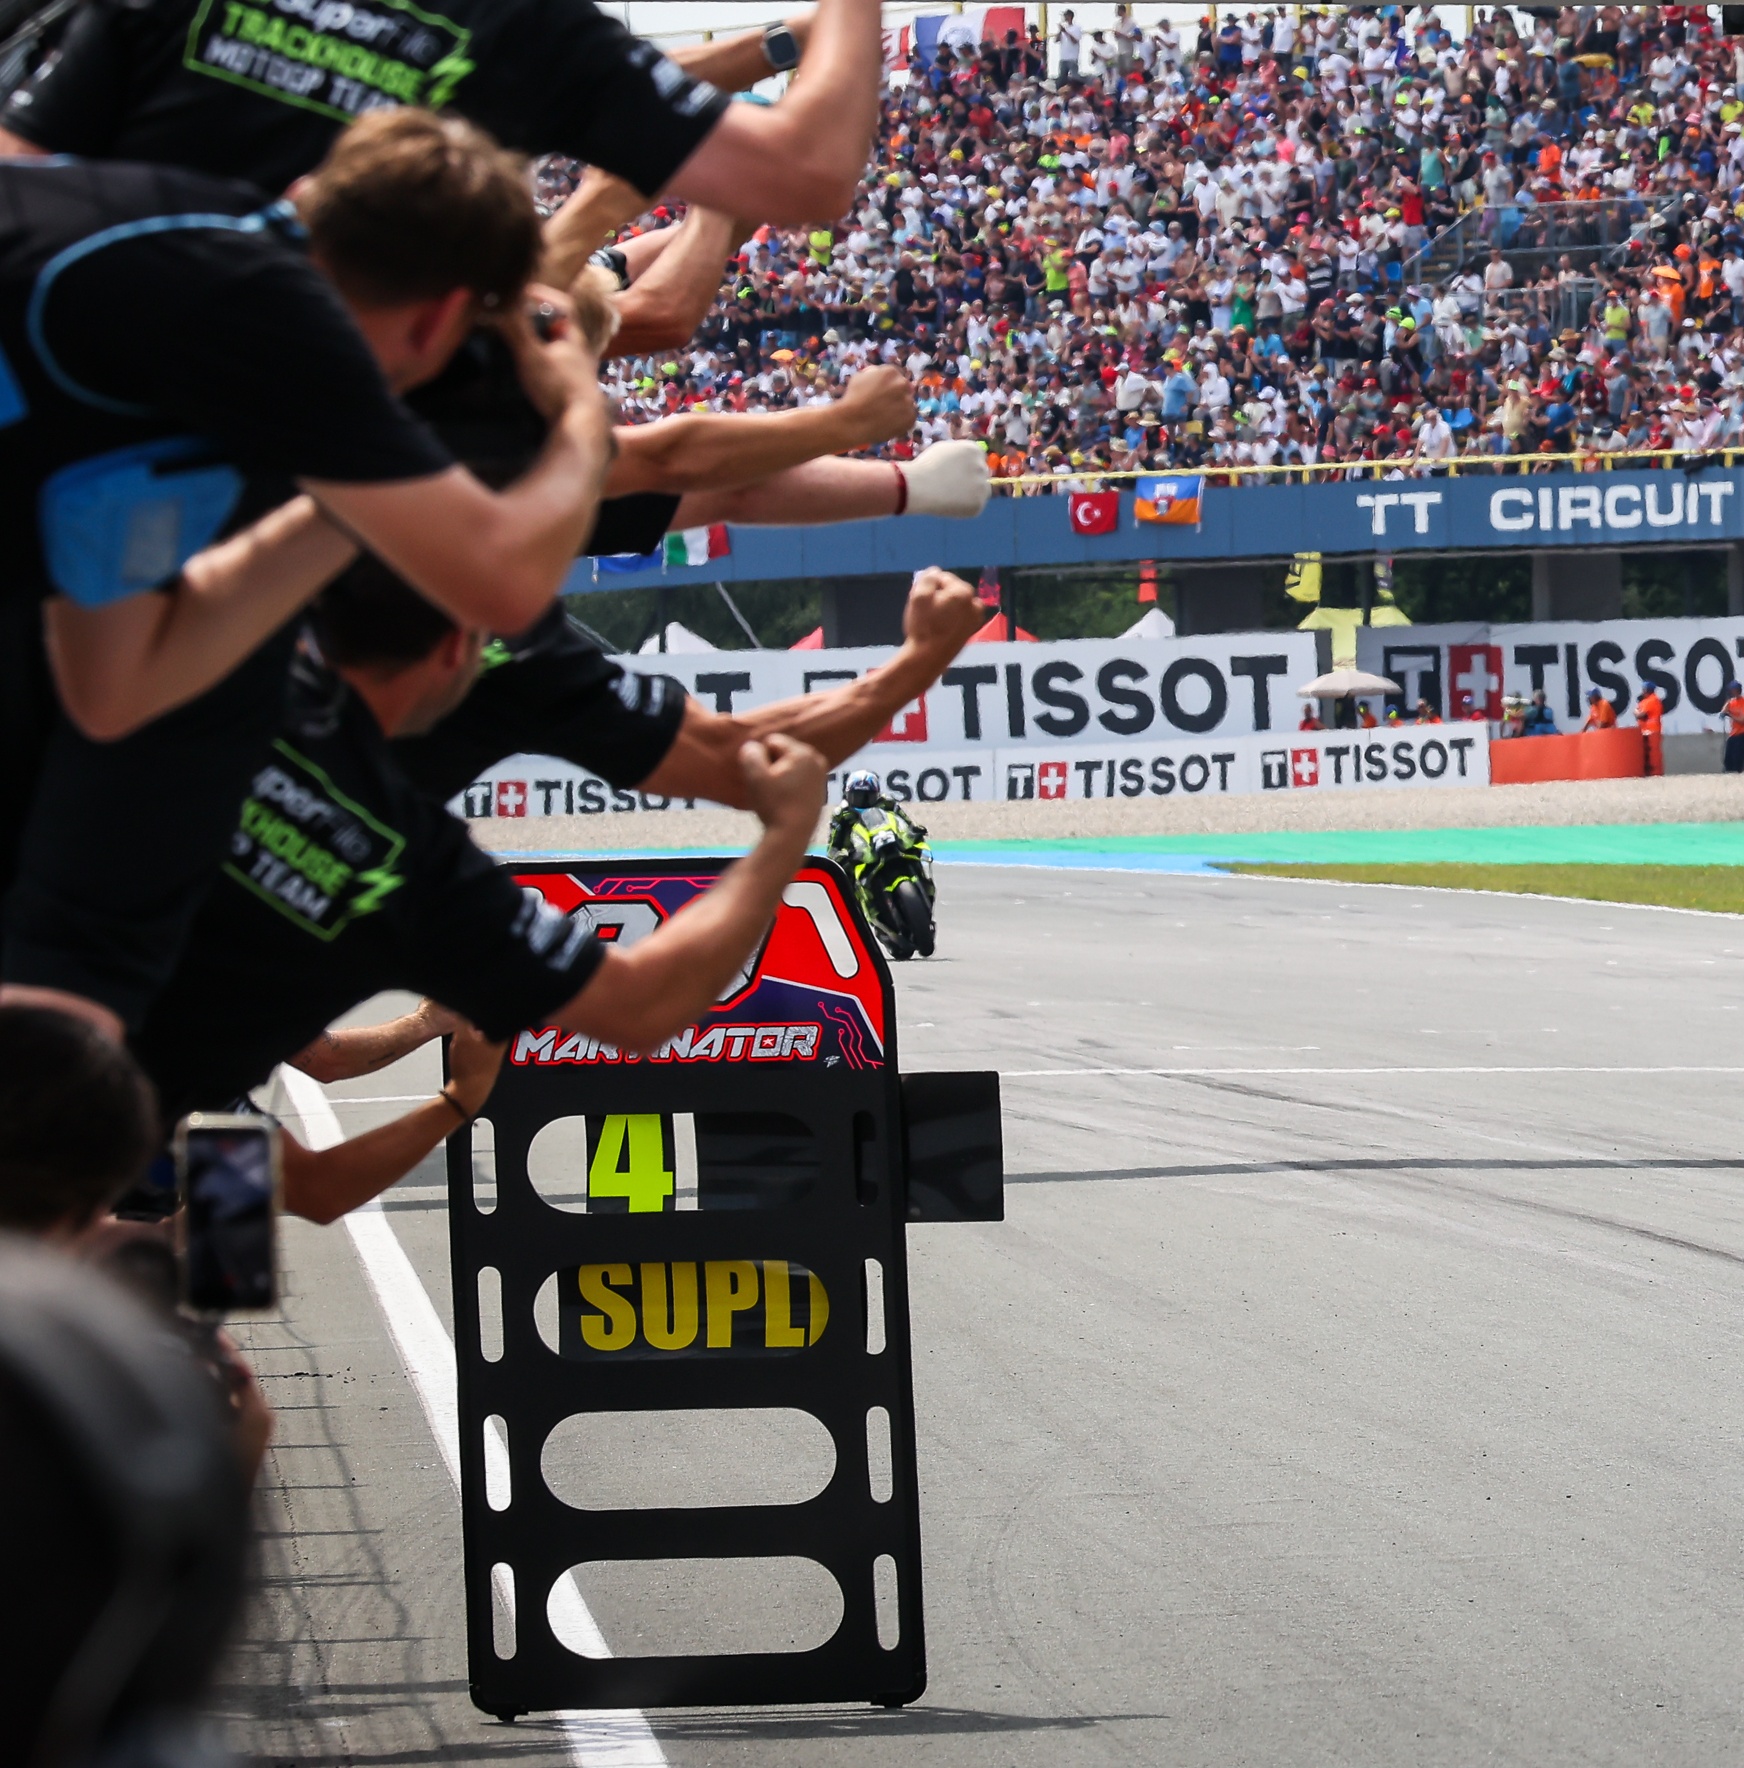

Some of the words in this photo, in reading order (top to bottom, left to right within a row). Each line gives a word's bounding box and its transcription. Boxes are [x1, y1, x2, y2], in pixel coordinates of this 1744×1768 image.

[1356, 491, 1442, 535] TT
[1490, 481, 1734, 531] CIRCUIT
[942, 655, 1288, 740] TISSOT
[1075, 753, 1235, 798] TISSOT
[1325, 738, 1474, 784] TISSOT
[250, 848, 332, 922] TEAM
[513, 1025, 819, 1062] MARNATOR
[588, 1113, 674, 1213] 4
